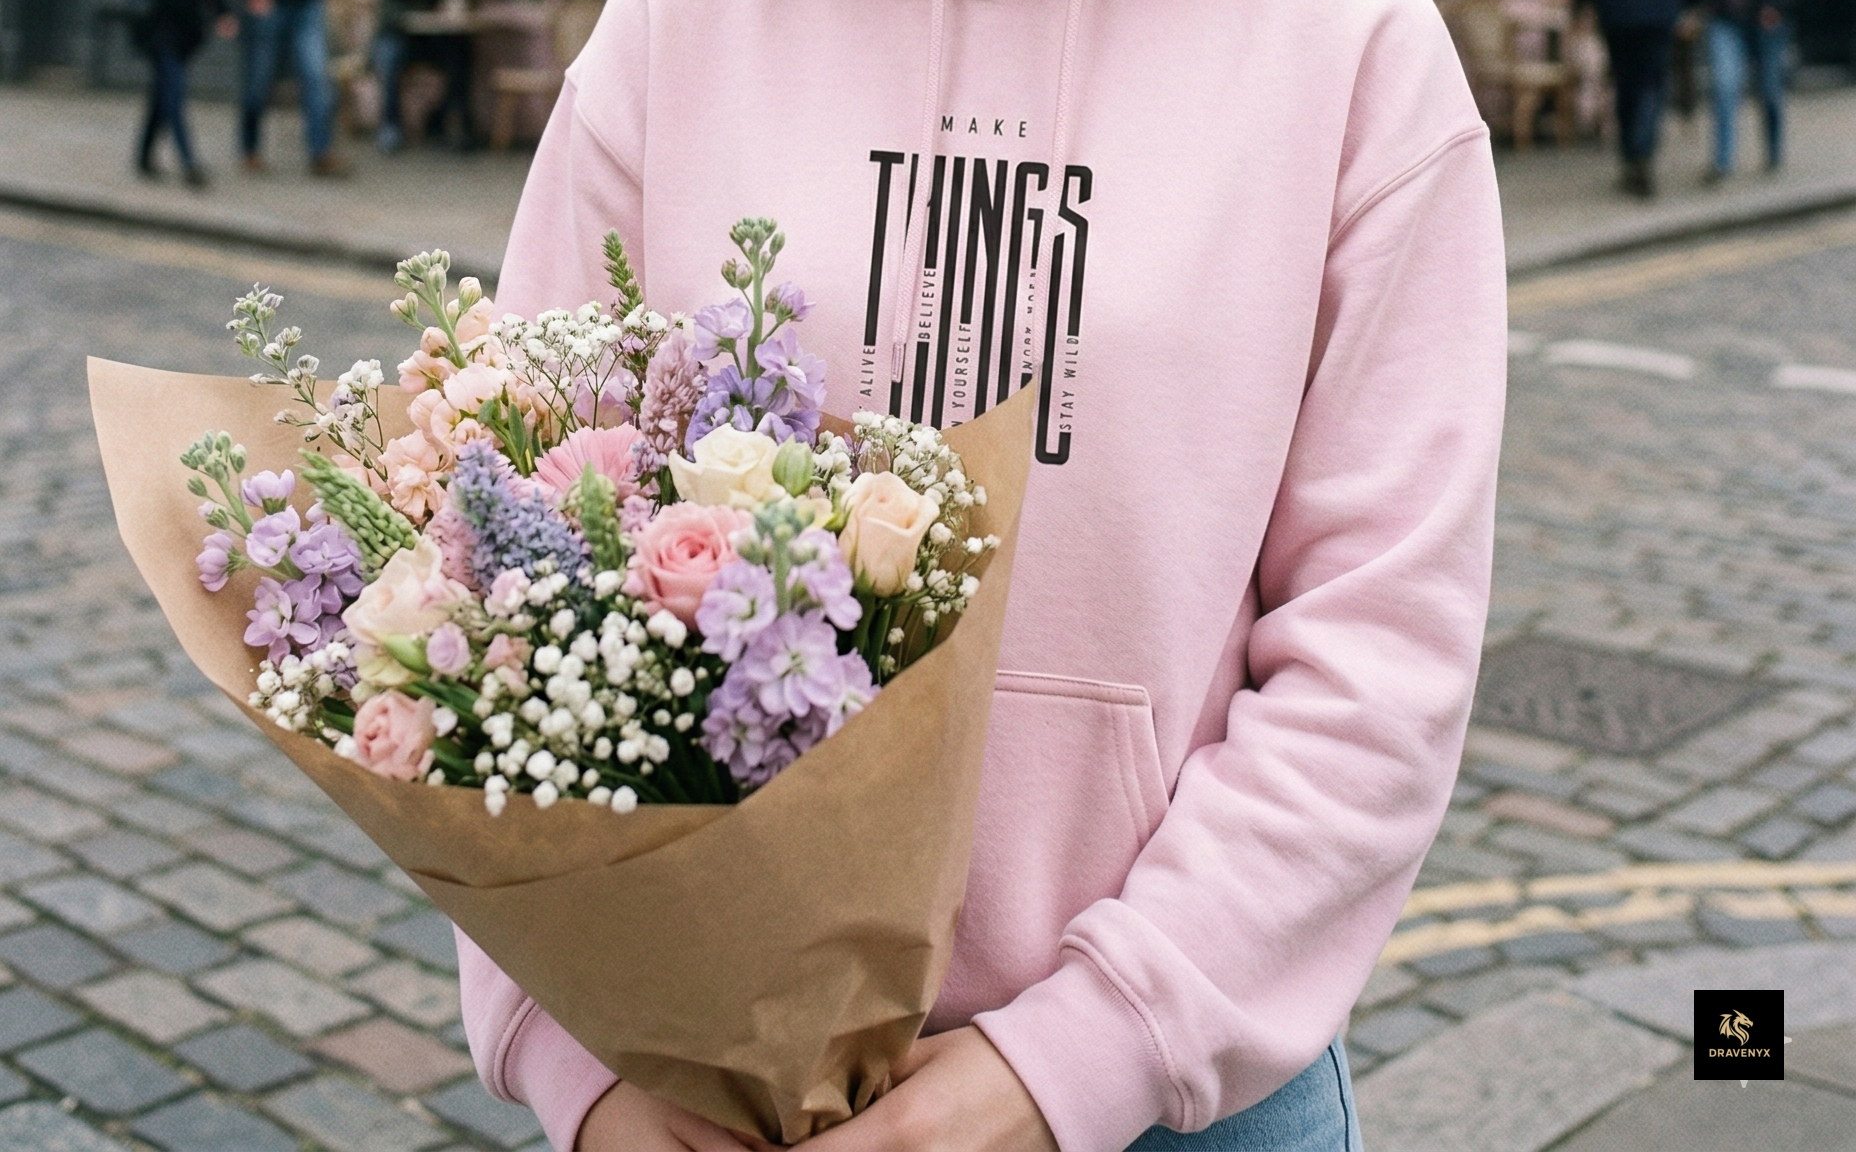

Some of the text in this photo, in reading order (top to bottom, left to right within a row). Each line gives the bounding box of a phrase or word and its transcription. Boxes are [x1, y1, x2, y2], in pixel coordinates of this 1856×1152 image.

[940, 115, 1027, 138] MAKE
[918, 269, 936, 340] BELIEVE
[860, 348, 876, 397] ALIVE
[951, 323, 971, 408] YOURSELF
[1059, 337, 1079, 430] STAY WILD
